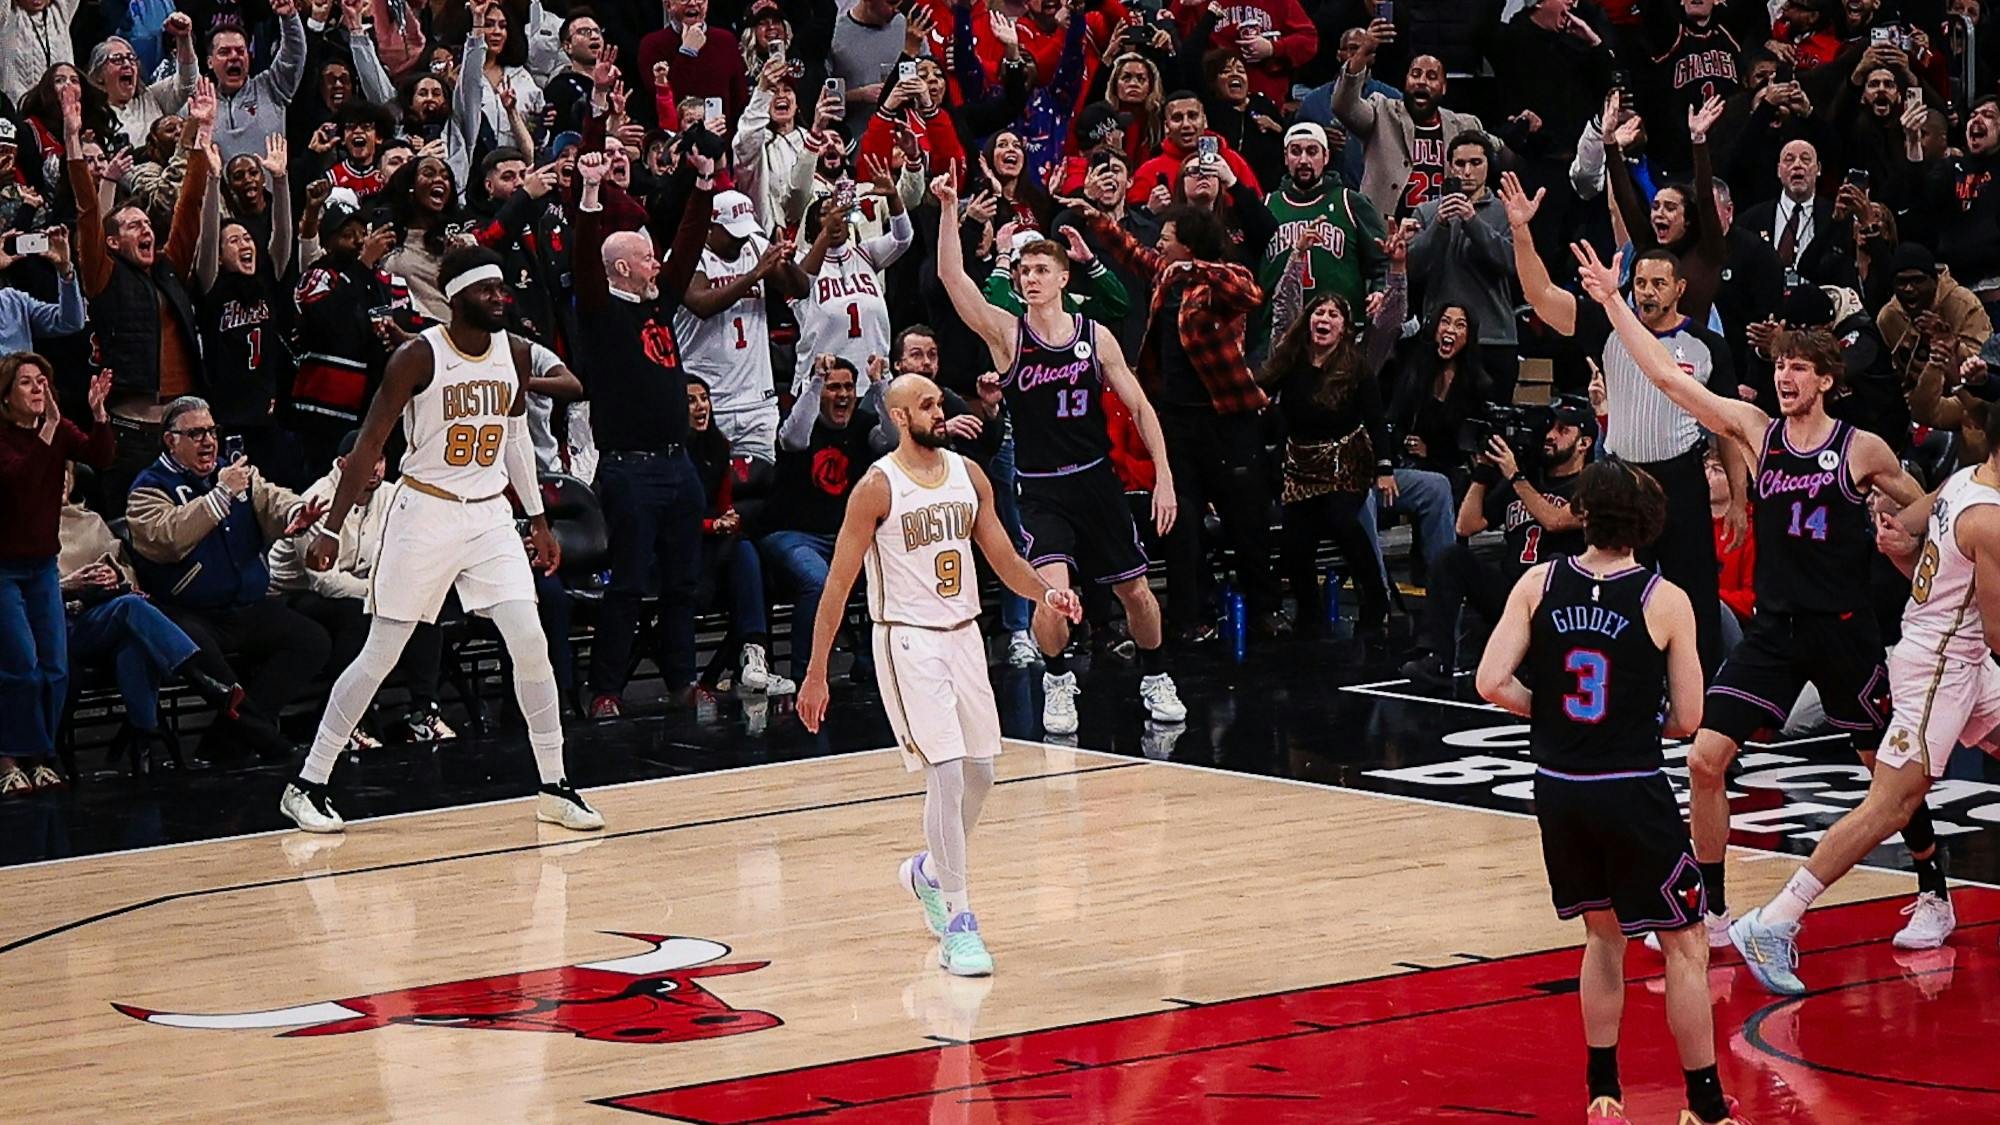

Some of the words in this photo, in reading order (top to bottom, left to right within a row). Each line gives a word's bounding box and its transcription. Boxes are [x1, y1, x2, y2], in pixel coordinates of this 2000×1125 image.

[1674, 50, 1738, 89] CHICAG
[816, 272, 879, 304] BULLS
[733, 316, 748, 349] 1
[846, 302, 862, 338] 1
[1018, 360, 1091, 391] Chicago
[442, 380, 512, 421] BOSTON
[1057, 389, 1089, 418] 13
[444, 423, 504, 467] 88
[1760, 468, 1835, 499] Chicago
[901, 501, 974, 553] BOSTON
[1787, 501, 1829, 541] 14
[1519, 524, 1542, 564] 1
[935, 549, 962, 598] 9
[1551, 605, 1630, 639] GIDDEY
[1562, 647, 1610, 724] 3
